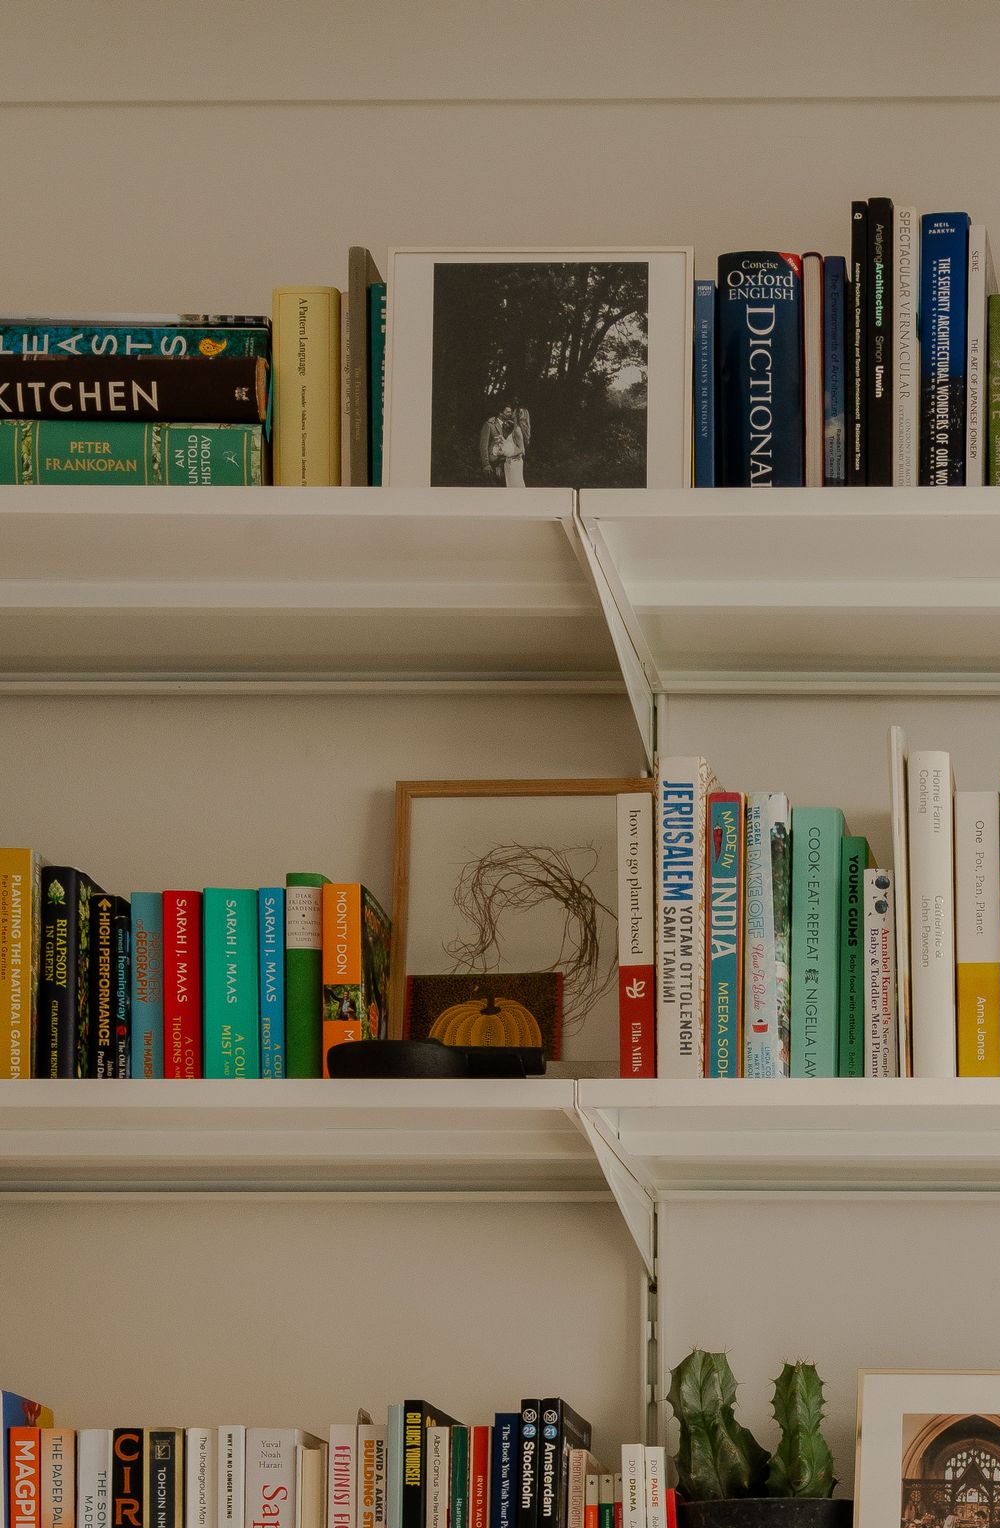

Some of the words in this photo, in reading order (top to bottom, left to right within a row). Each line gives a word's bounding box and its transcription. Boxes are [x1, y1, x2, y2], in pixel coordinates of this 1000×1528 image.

[741, 260, 779, 269] Concise
[899, 211, 911, 297] SPECTACULAR
[727, 270, 794, 287] Oxford
[729, 289, 793, 300] ENGLISH
[299, 306, 308, 335] Pattern
[298, 337, 308, 376] Language
[875, 336, 884, 362] Simon
[899, 302, 911, 400] VERNACULAR
[875, 365, 884, 398] Unwin
[46, 458, 137, 471] FRANKOPAN
[70, 441, 112, 454] PETER
[175, 449, 184, 468] AN
[189, 434, 198, 484] UNTOLD
[202, 435, 212, 485] HISTORY
[629, 809, 642, 838] how
[662, 780, 694, 901] JERUSALEM
[721, 811, 738, 852] MADE
[975, 821, 985, 844] One
[626, 859, 639, 875] go
[629, 842, 641, 856] to
[974, 852, 985, 872] Pot,
[848, 855, 859, 904] YOUNG
[974, 875, 985, 898] Pan,
[11, 874, 22, 940] PLANTING
[176, 898, 187, 944] SARAH
[226, 900, 237, 945] SARAH
[336, 891, 347, 938] MONTY
[627, 878, 644, 955] plant-based
[663, 906, 676, 943] SAMI
[711, 876, 737, 960] INDIA
[975, 902, 986, 935] Planet
[45, 925, 54, 938] IN
[99, 912, 110, 946] HIGH
[680, 906, 692, 957] YOTAM
[848, 908, 858, 947] GUMS
[11, 944, 21, 964] THE
[44, 941, 54, 981] GREEN
[55, 919, 67, 988] RHAPSODY
[336, 944, 347, 975] DON
[176, 962, 188, 1003] MAAS
[226, 964, 238, 1004] MAAS
[663, 950, 676, 1004] TAMIMI
[10, 968, 21, 1025] NATURAL
[98, 948, 111, 1046] PERFORMANCE
[680, 963, 692, 1056] OTTOLENGHI
[976, 996, 986, 1024] Anna
[631, 1022, 642, 1041] Ella
[976, 1027, 987, 1060] Jones
[631, 1044, 643, 1072] Mills
[406, 1412, 421, 1424] GO
[406, 1425, 421, 1446] LUCK
[52, 1435, 62, 1460] THE
[52, 1464, 62, 1503] PAPER
[97, 1471, 107, 1497] THE
[333, 1445, 352, 1506] FEMINIST
[362, 1440, 374, 1507] BUILDING
[405, 1448, 420, 1486] YOURSELF
[521, 1441, 535, 1509] Stockholm
[543, 1442, 556, 1516] Amsterdam
